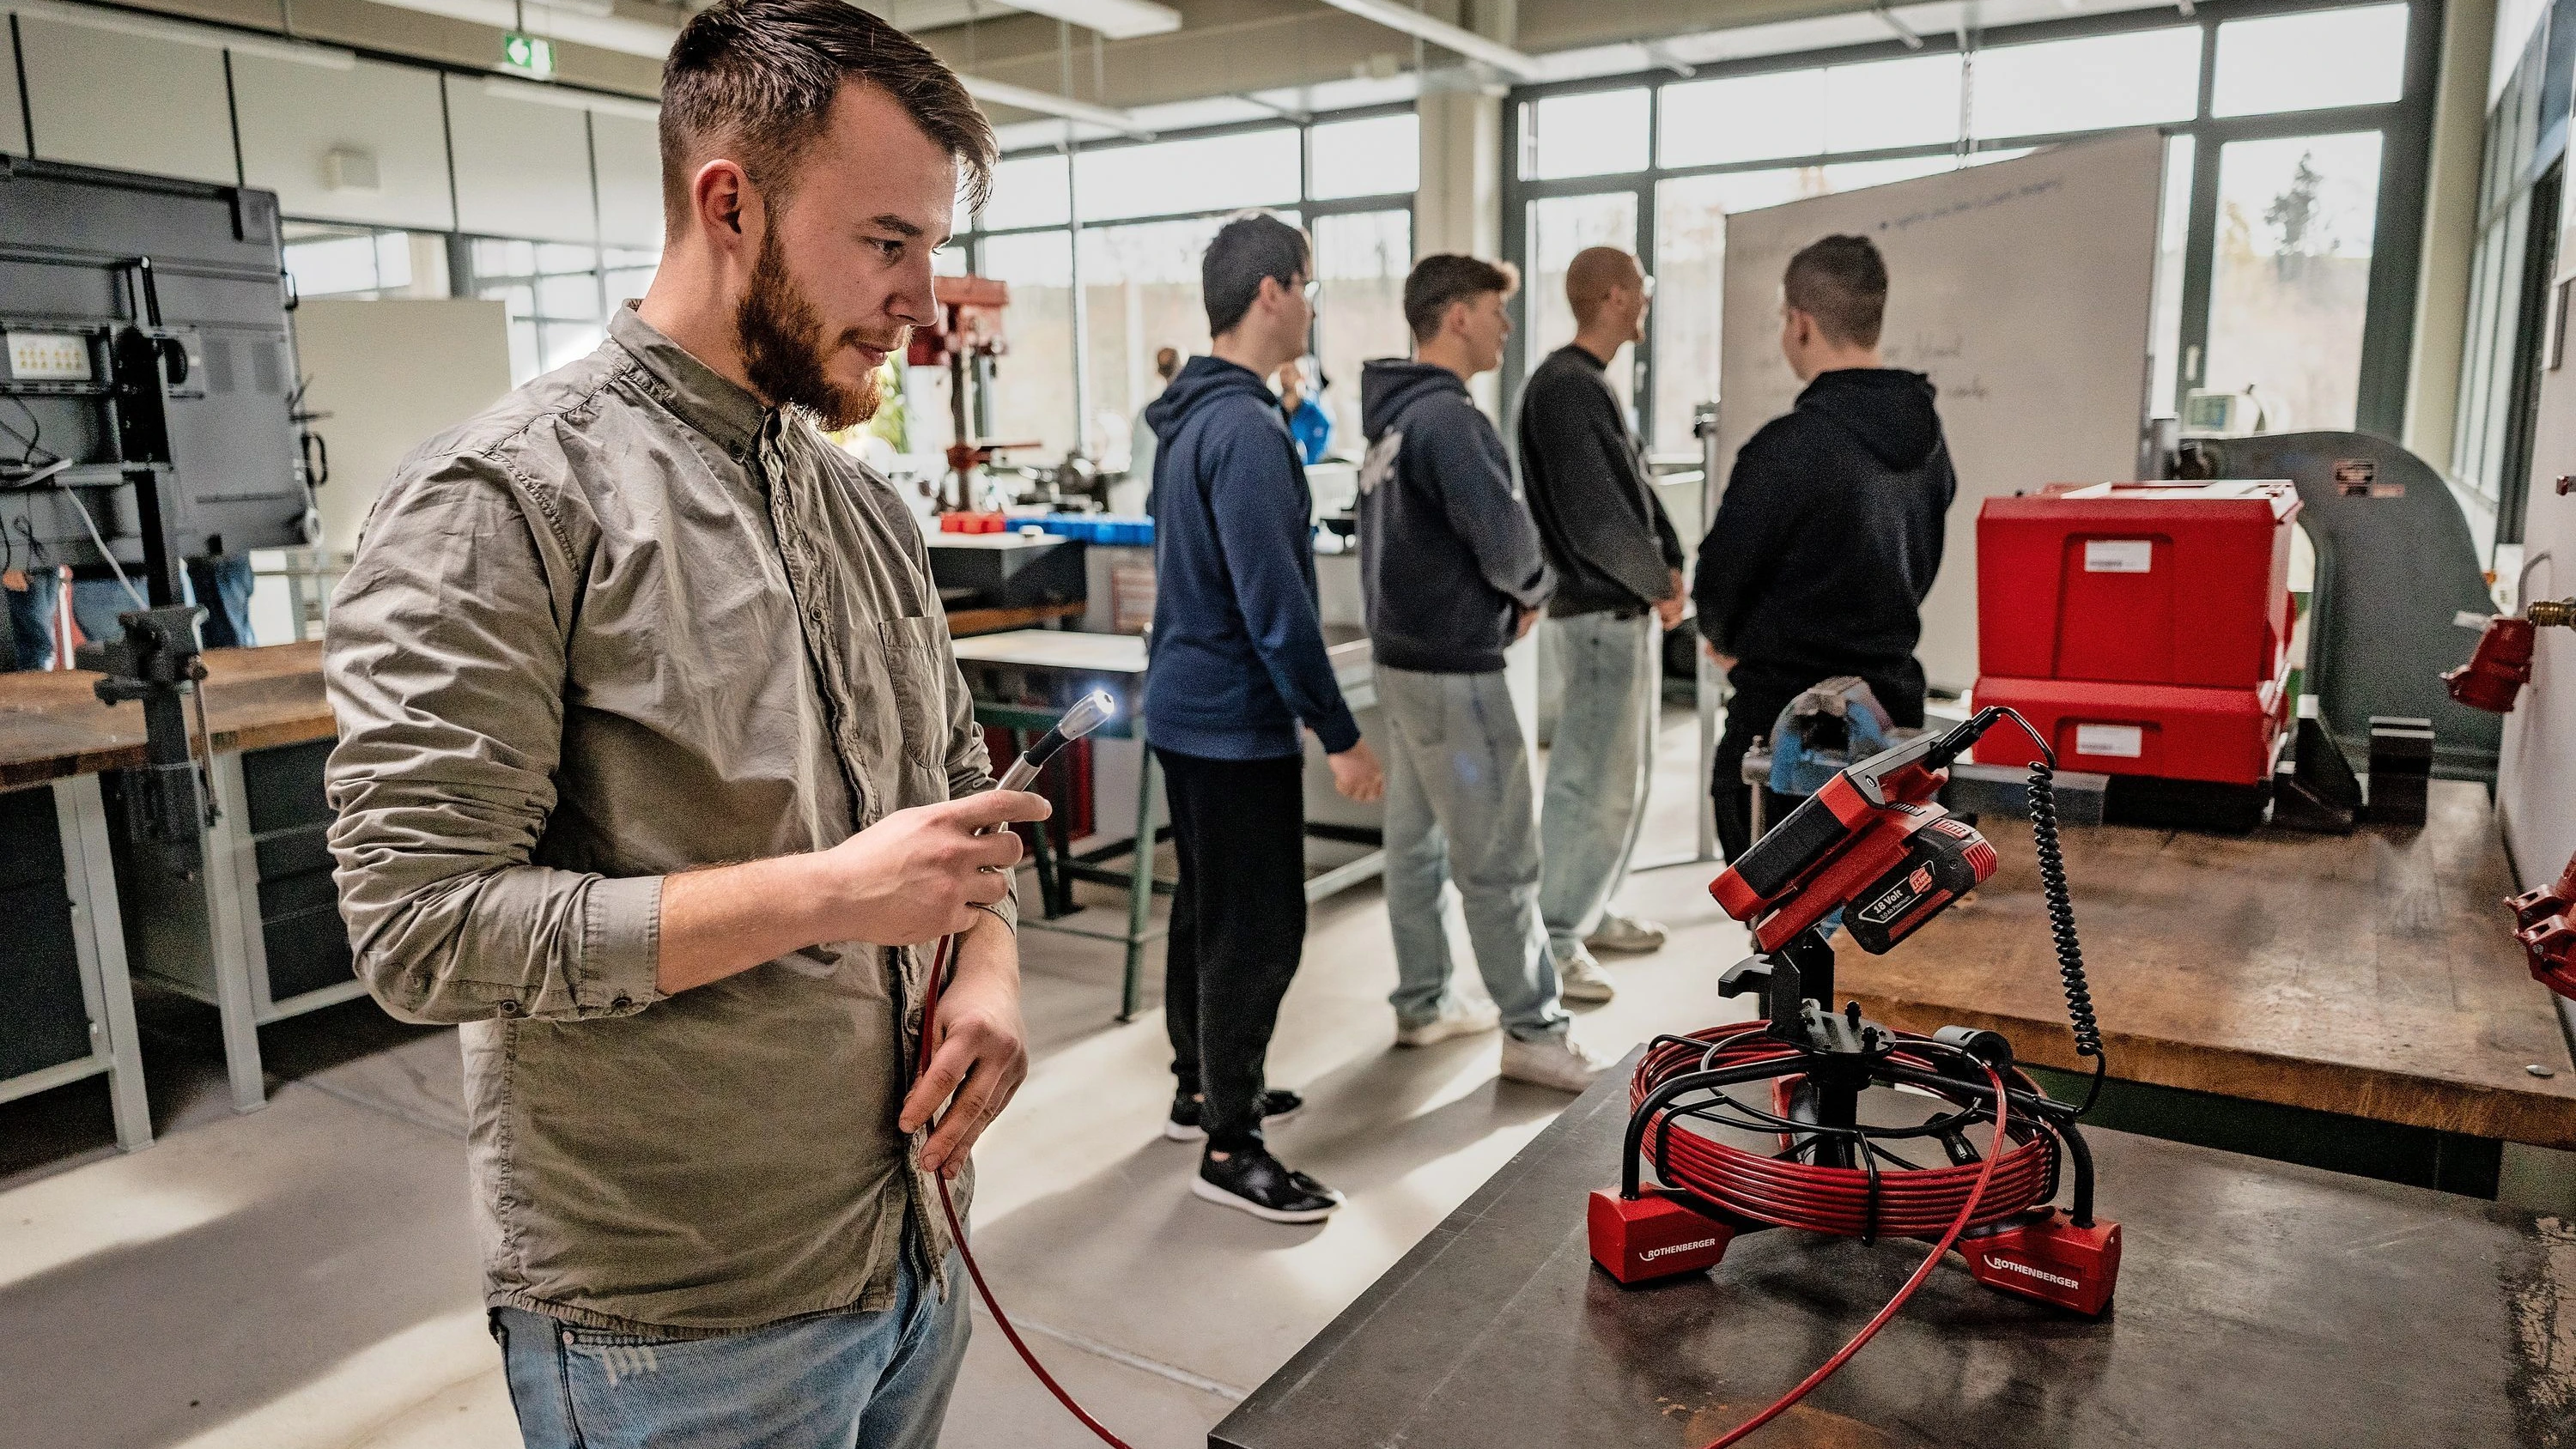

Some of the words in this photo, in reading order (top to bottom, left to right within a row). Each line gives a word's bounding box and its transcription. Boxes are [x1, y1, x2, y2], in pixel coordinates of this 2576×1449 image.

[1874, 901, 1886, 914] 18
[1883, 889, 1904, 906] Volt
[1892, 895, 1911, 910] Premium
[1648, 1238, 1716, 1258] ROTHENBERGER
[1994, 1258, 2079, 1289] ROTHENBERGER
